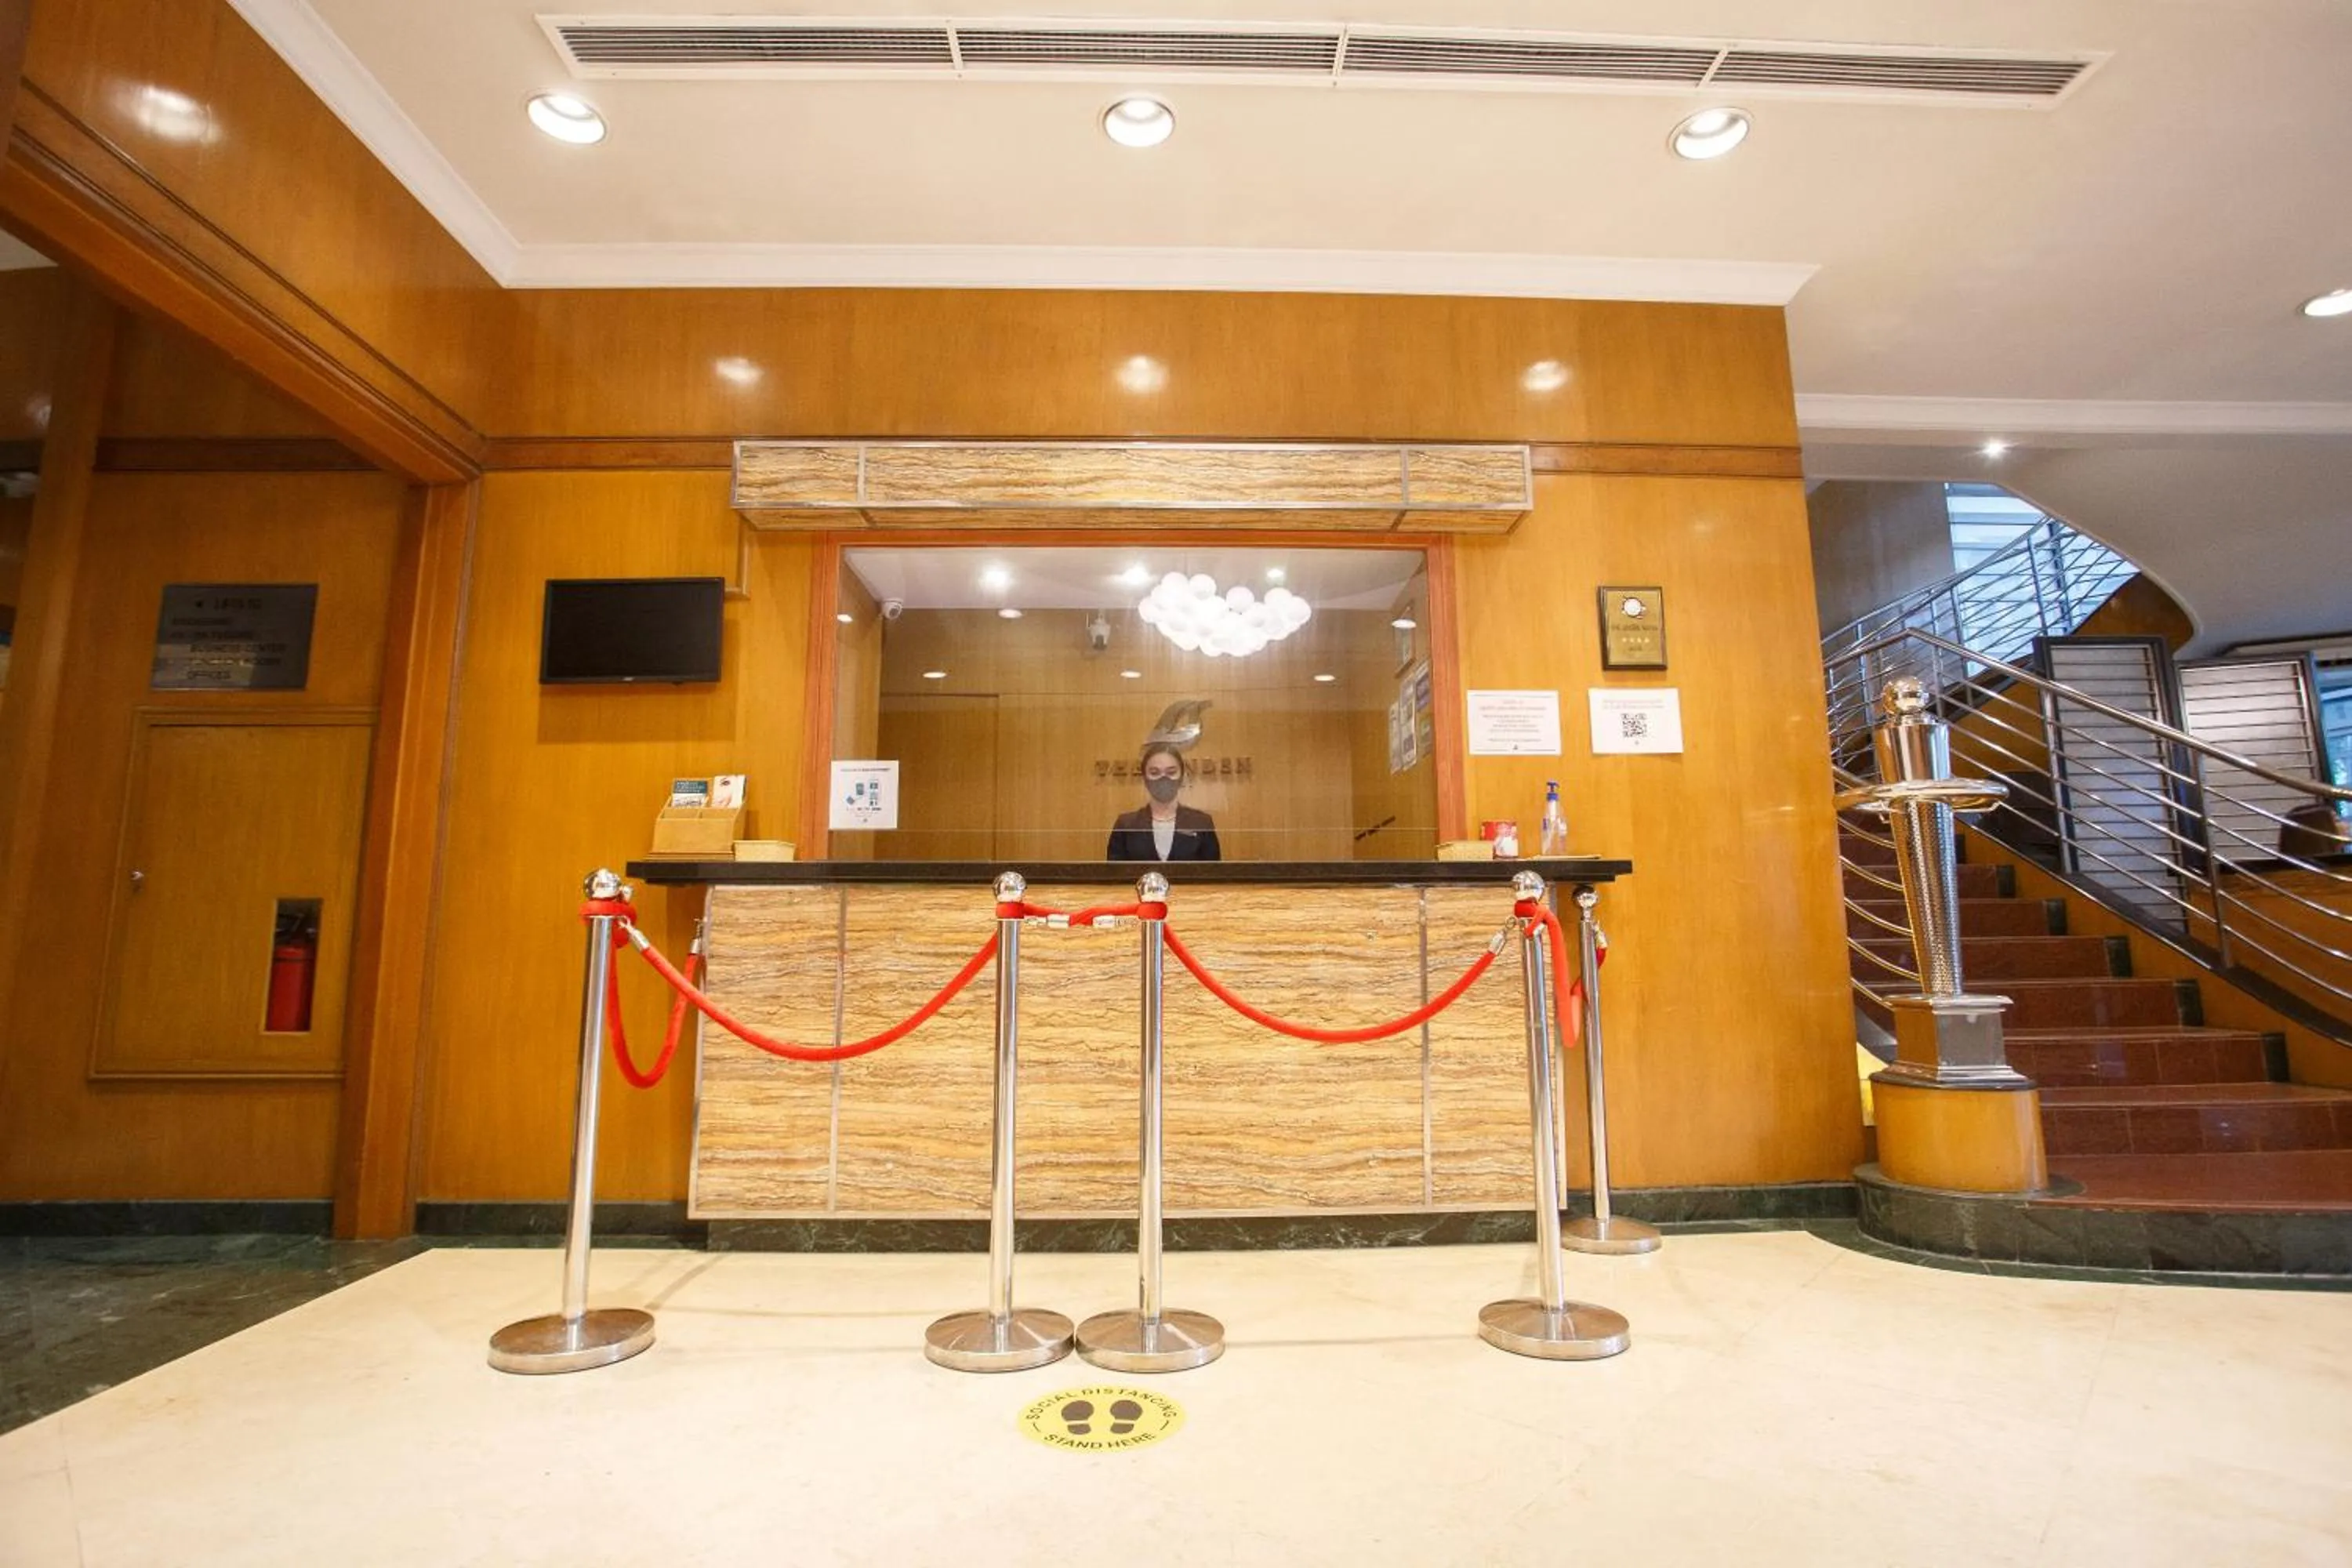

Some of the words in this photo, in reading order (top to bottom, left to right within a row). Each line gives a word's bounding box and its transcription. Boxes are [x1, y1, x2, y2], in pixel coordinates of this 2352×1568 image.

[1025, 1392, 1078, 1420] SOCIAL
[1081, 1388, 1178, 1417] DISTANCING
[1044, 1433, 1103, 1449] STAND
[1107, 1432, 1156, 1448] HERE
